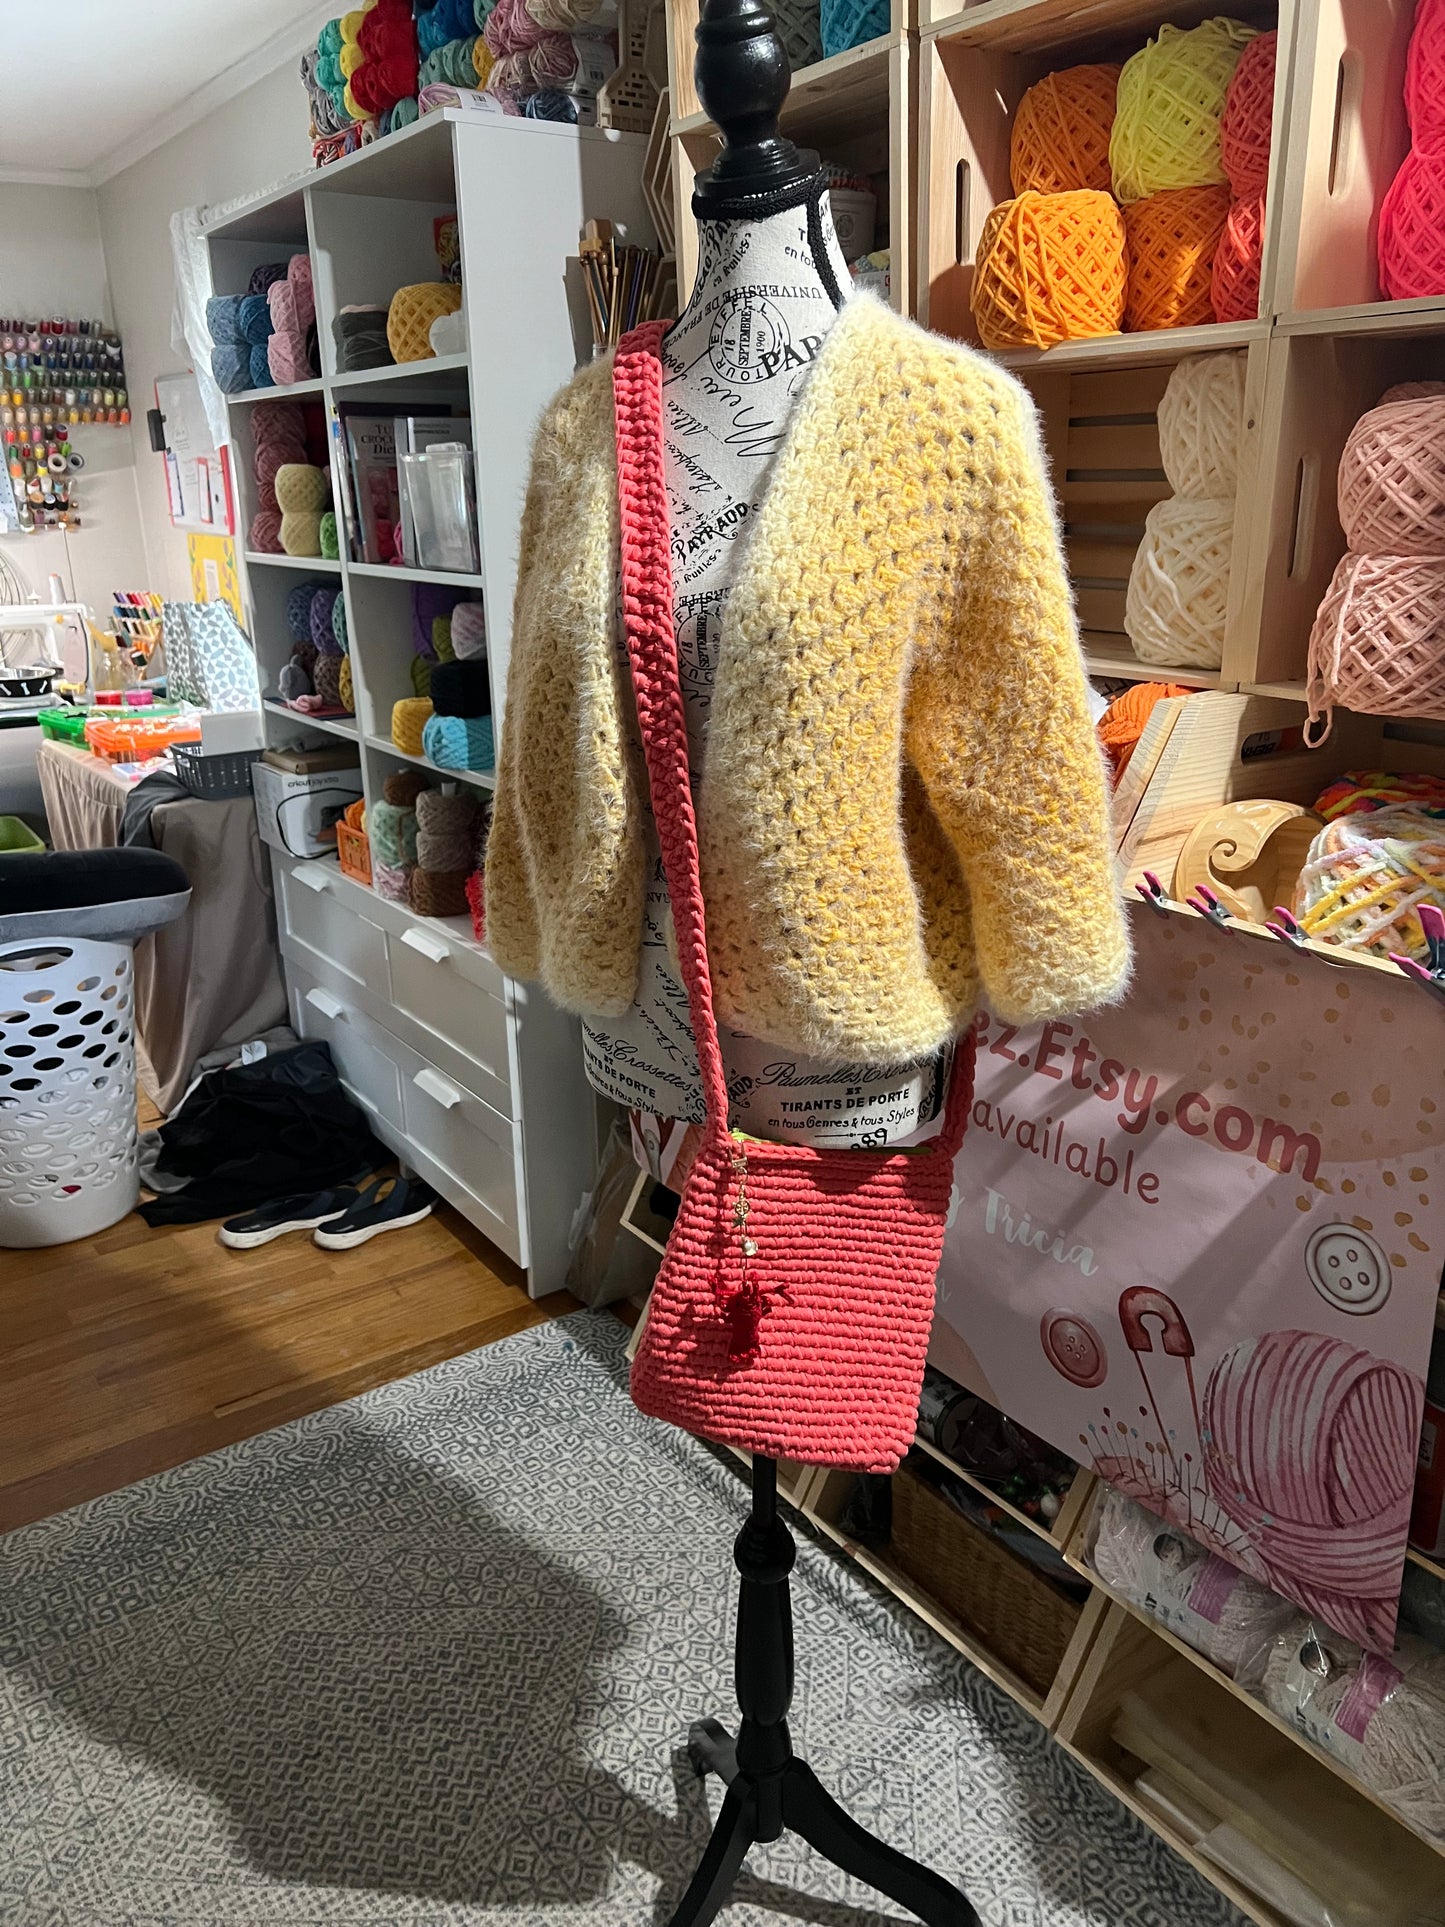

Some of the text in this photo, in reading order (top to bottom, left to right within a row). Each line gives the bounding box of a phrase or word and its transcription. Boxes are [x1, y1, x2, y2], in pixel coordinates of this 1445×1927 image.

[784, 245, 798, 260] en
[703, 296, 721, 316] DE
[724, 338, 736, 352] 18
[738, 307, 752, 367] SEPTEMBRE
[755, 330, 766, 354] 1900
[716, 356, 764, 381] TOUR
[758, 336, 822, 379] PAR
[682, 640, 693, 653] 18
[288, 779, 310, 788] cricut
[614, 1039, 694, 1092] Crossettes
[604, 1064, 618, 1080] DE
[618, 1072, 657, 1099] PORTE
[845, 1087, 862, 1096] ET
[780, 1088, 911, 1113] TIRANTS DE PORTE
[768, 1106, 916, 1129] en tous Genres & tous Styles
[850, 1127, 888, 1150] 89
[972, 1099, 1161, 1205] available
[984, 1185, 1099, 1277] Tricia
